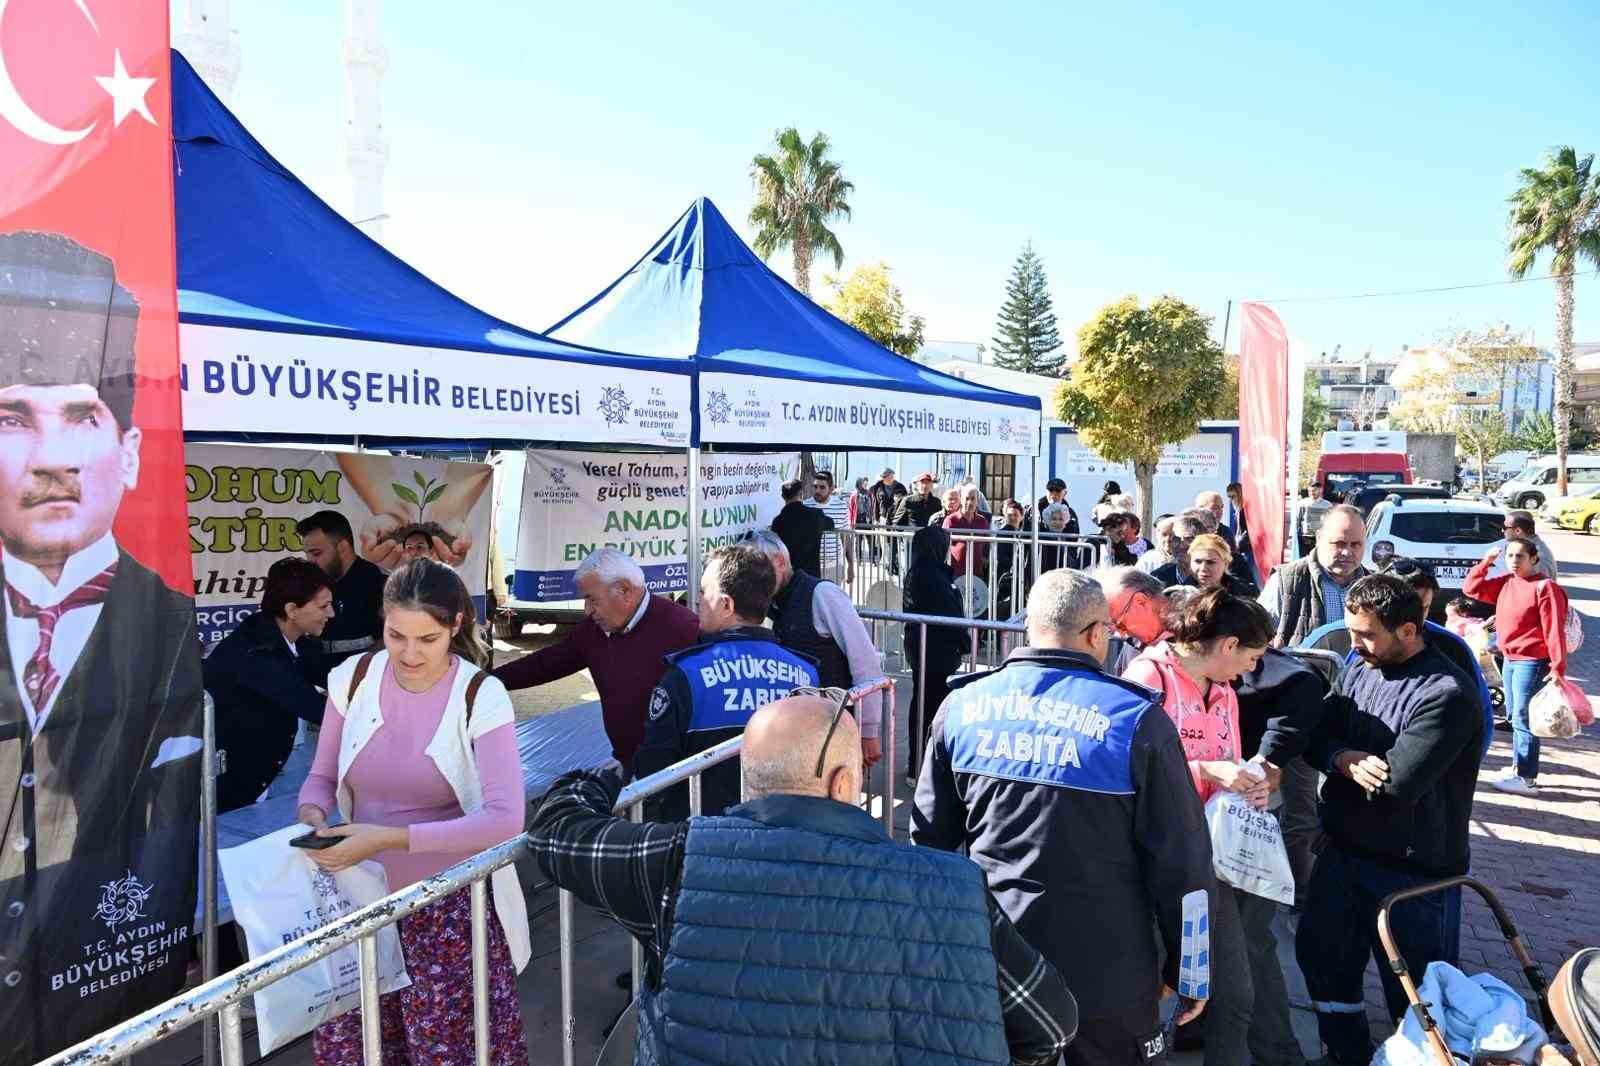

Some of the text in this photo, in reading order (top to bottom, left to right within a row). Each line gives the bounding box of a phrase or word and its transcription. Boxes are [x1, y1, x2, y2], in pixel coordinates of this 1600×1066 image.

[203, 355, 441, 410] BÜYÜKŞEHİR
[452, 386, 580, 416] BELEDİYESİ
[634, 408, 679, 420] BÜYÜKŞEHİR
[781, 402, 804, 421] T.C.
[808, 404, 847, 424] AYDIN
[851, 402, 935, 434] BÜYÜKŞEHİR
[938, 416, 991, 437] BELEDİYESİ
[185, 464, 342, 505] OHUM
[582, 461, 622, 477] Yerel
[628, 462, 679, 479] Tohum,
[723, 462, 743, 477] besin
[597, 483, 642, 502] güçlü
[702, 484, 734, 500] yapıya
[604, 504, 758, 533] ANADLU'NUN
[701, 654, 812, 689] BÜYÜKŞEHİR
[961, 688, 1111, 743] BÜYÜKŞEHİR
[976, 729, 1082, 769] ZABITA
[84, 920, 167, 957] T.C. AYDIN
[51, 926, 188, 991] BÜYÜKŞEHİR
[79, 952, 169, 998] BELEDİYESİ
